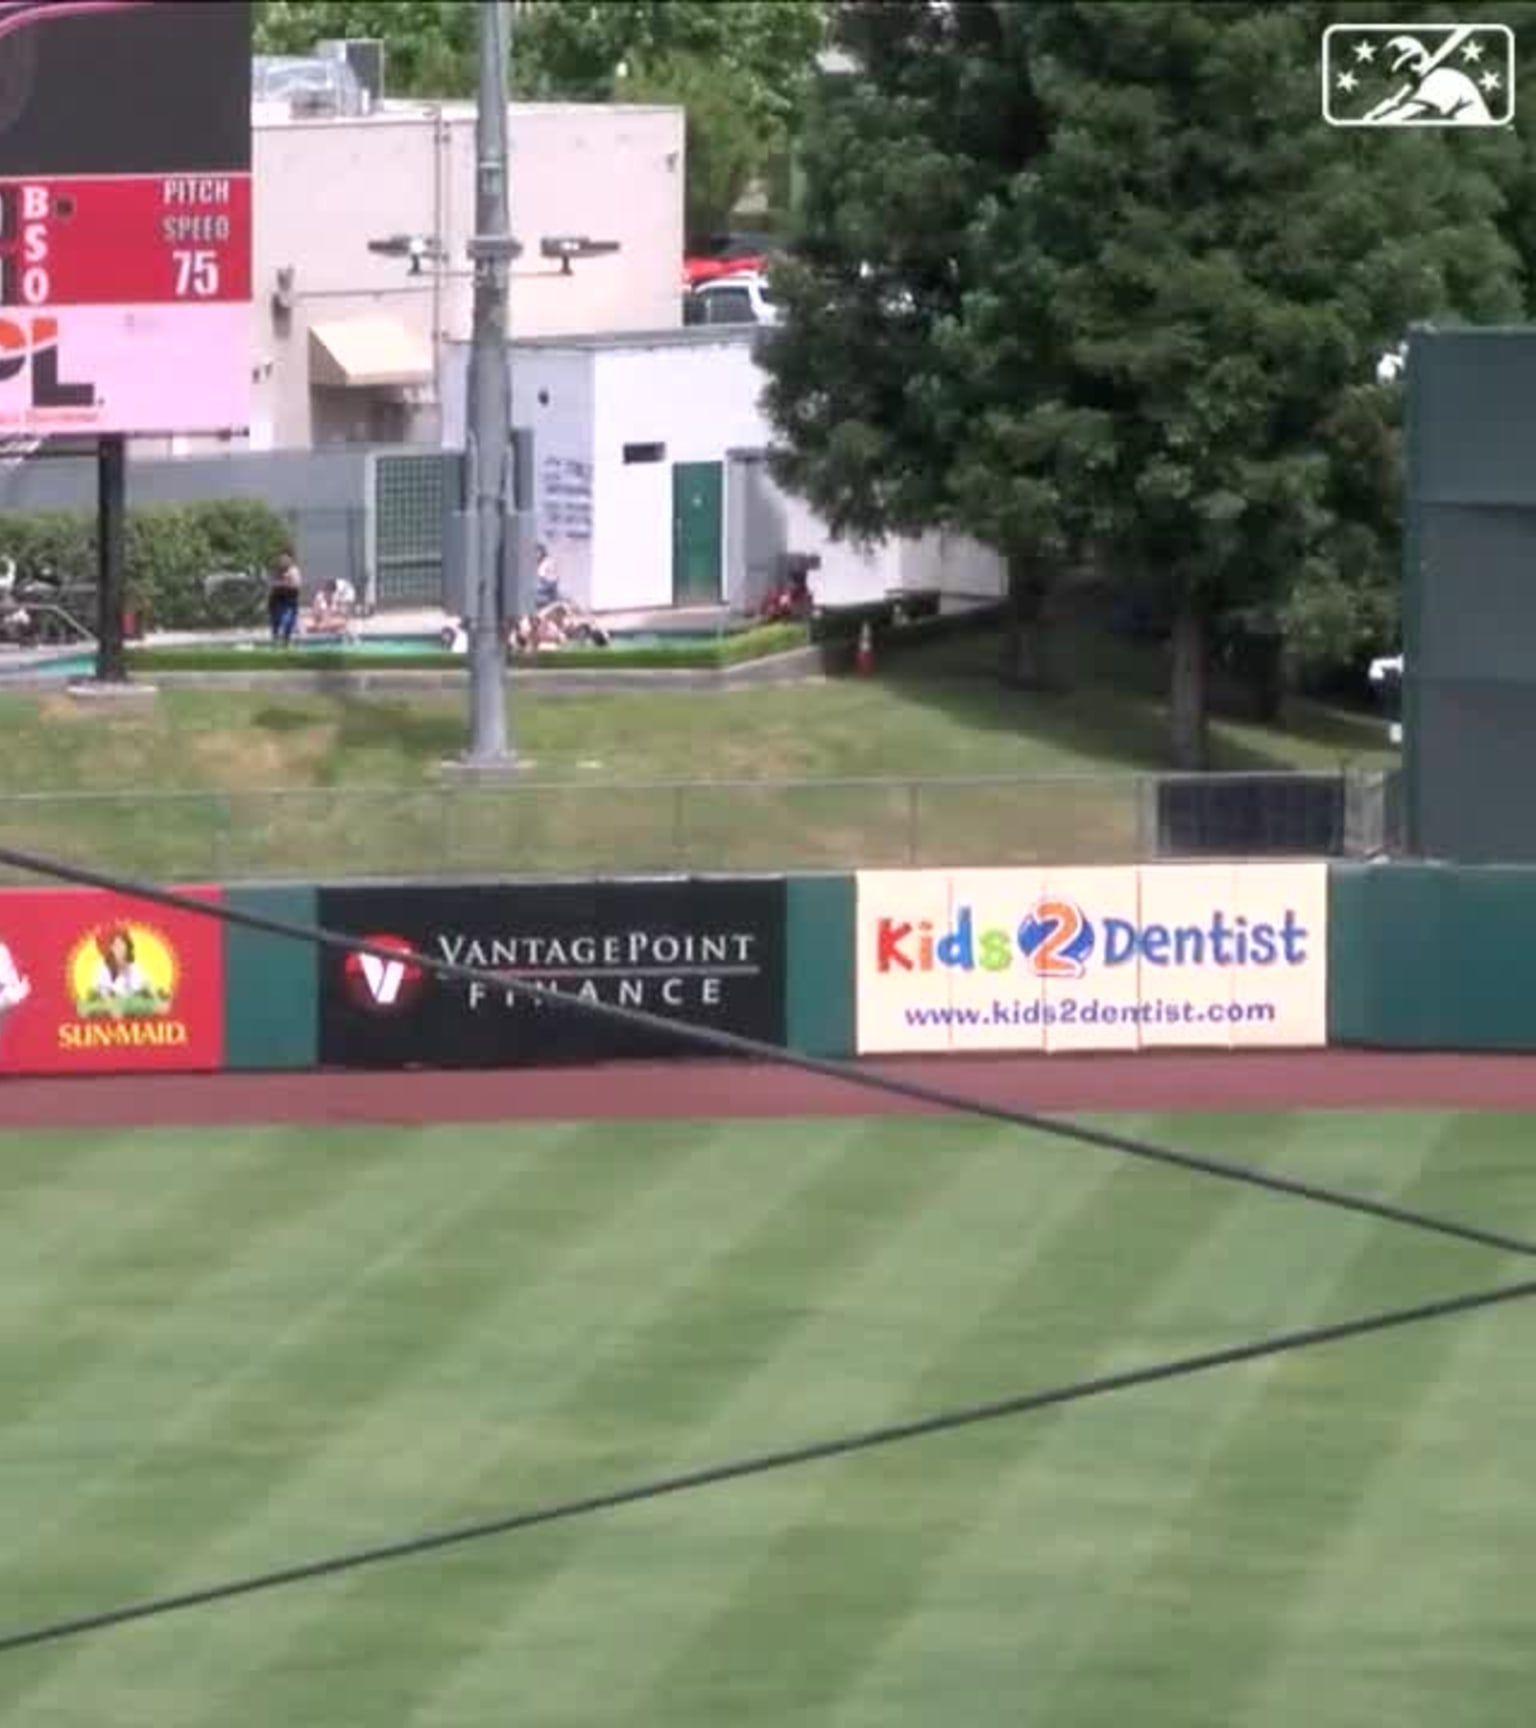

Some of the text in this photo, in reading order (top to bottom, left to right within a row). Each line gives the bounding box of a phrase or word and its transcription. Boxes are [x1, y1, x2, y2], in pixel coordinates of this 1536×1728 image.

[164, 178, 230, 205] PITCH
[162, 214, 230, 242] SPEED
[172, 249, 220, 296] 75
[875, 898, 1309, 979] Kids 2 Dentist
[905, 1001, 1277, 1027] www.kids2dentist.com
